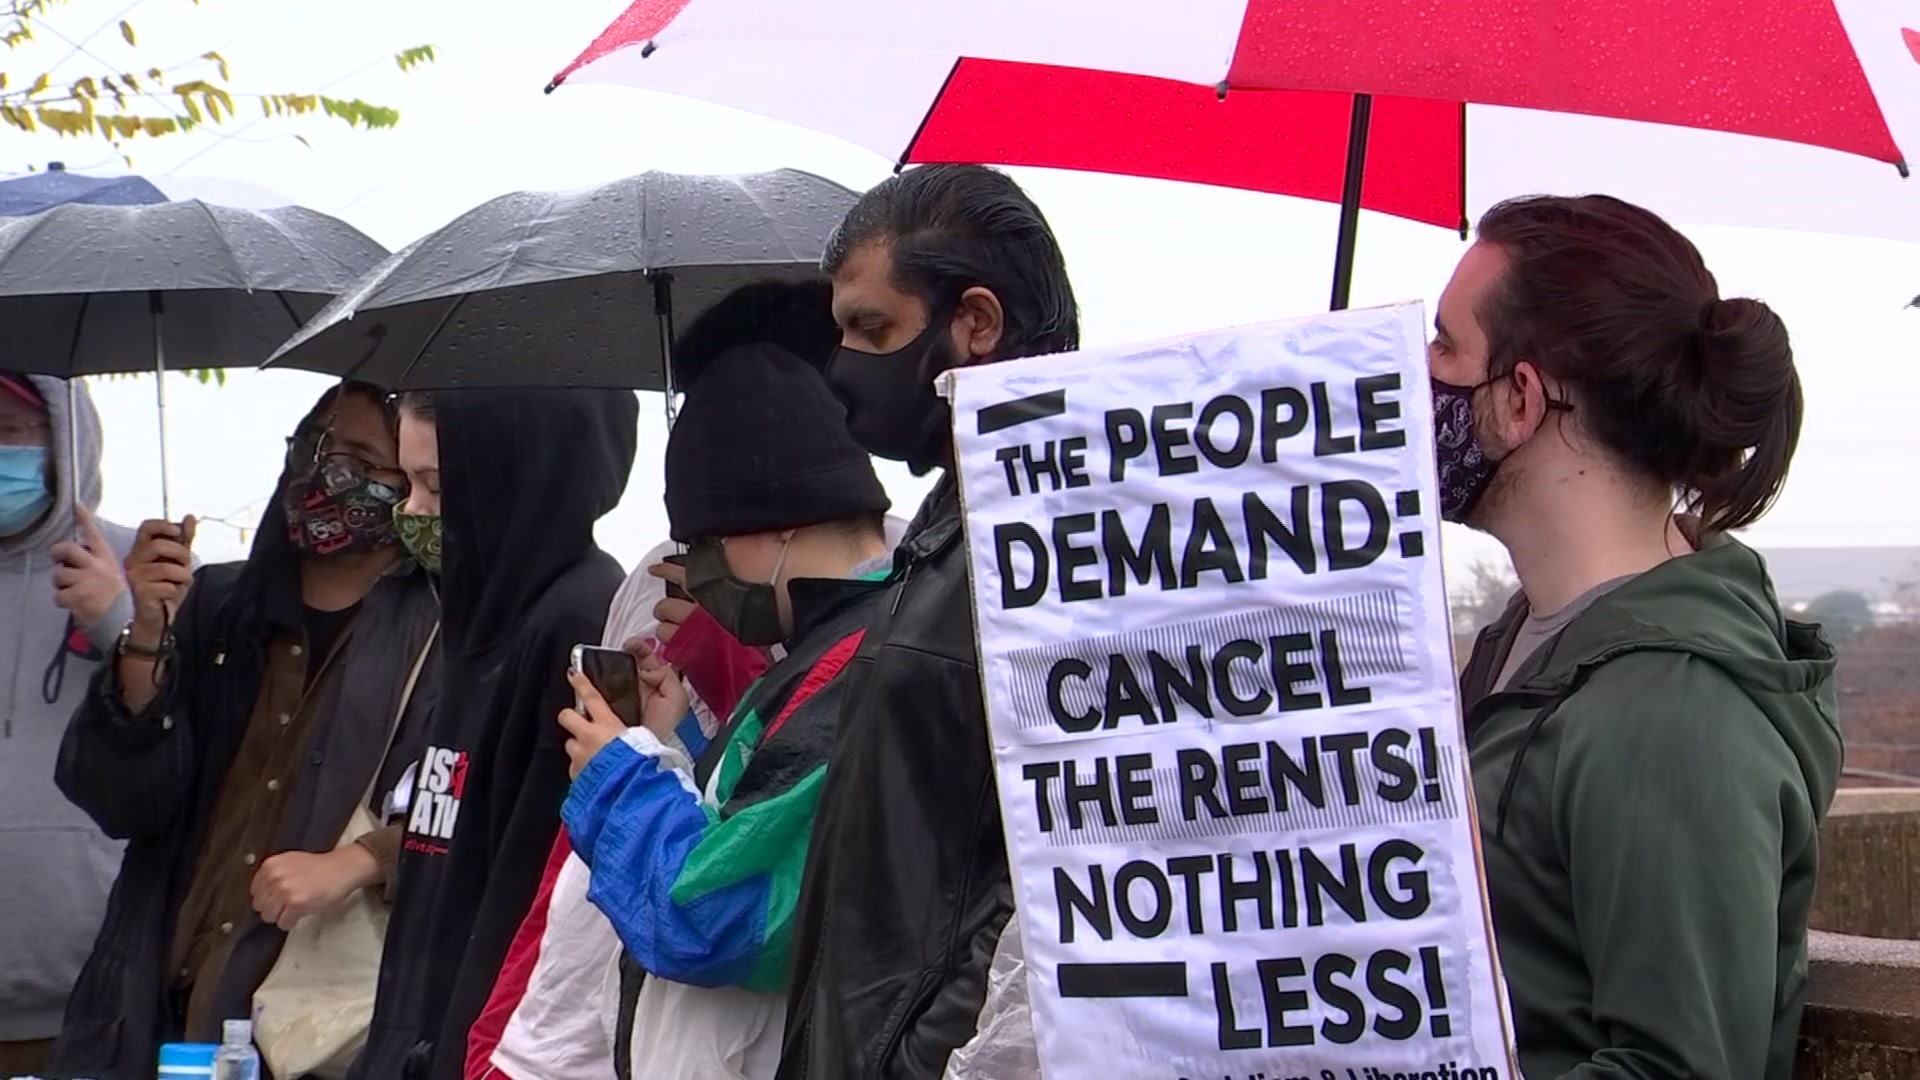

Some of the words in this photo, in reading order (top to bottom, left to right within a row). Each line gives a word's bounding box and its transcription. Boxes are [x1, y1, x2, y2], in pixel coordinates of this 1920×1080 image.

[996, 437, 1090, 496] THE
[1105, 372, 1406, 482] PEOPLE
[993, 479, 1424, 610] DEMAND:
[1046, 629, 1372, 733] CANCEL
[1022, 752, 1160, 833] THE
[1177, 727, 1441, 822] RENTS!
[1053, 839, 1431, 944] NOTHING
[1211, 946, 1452, 1050] LESS!
